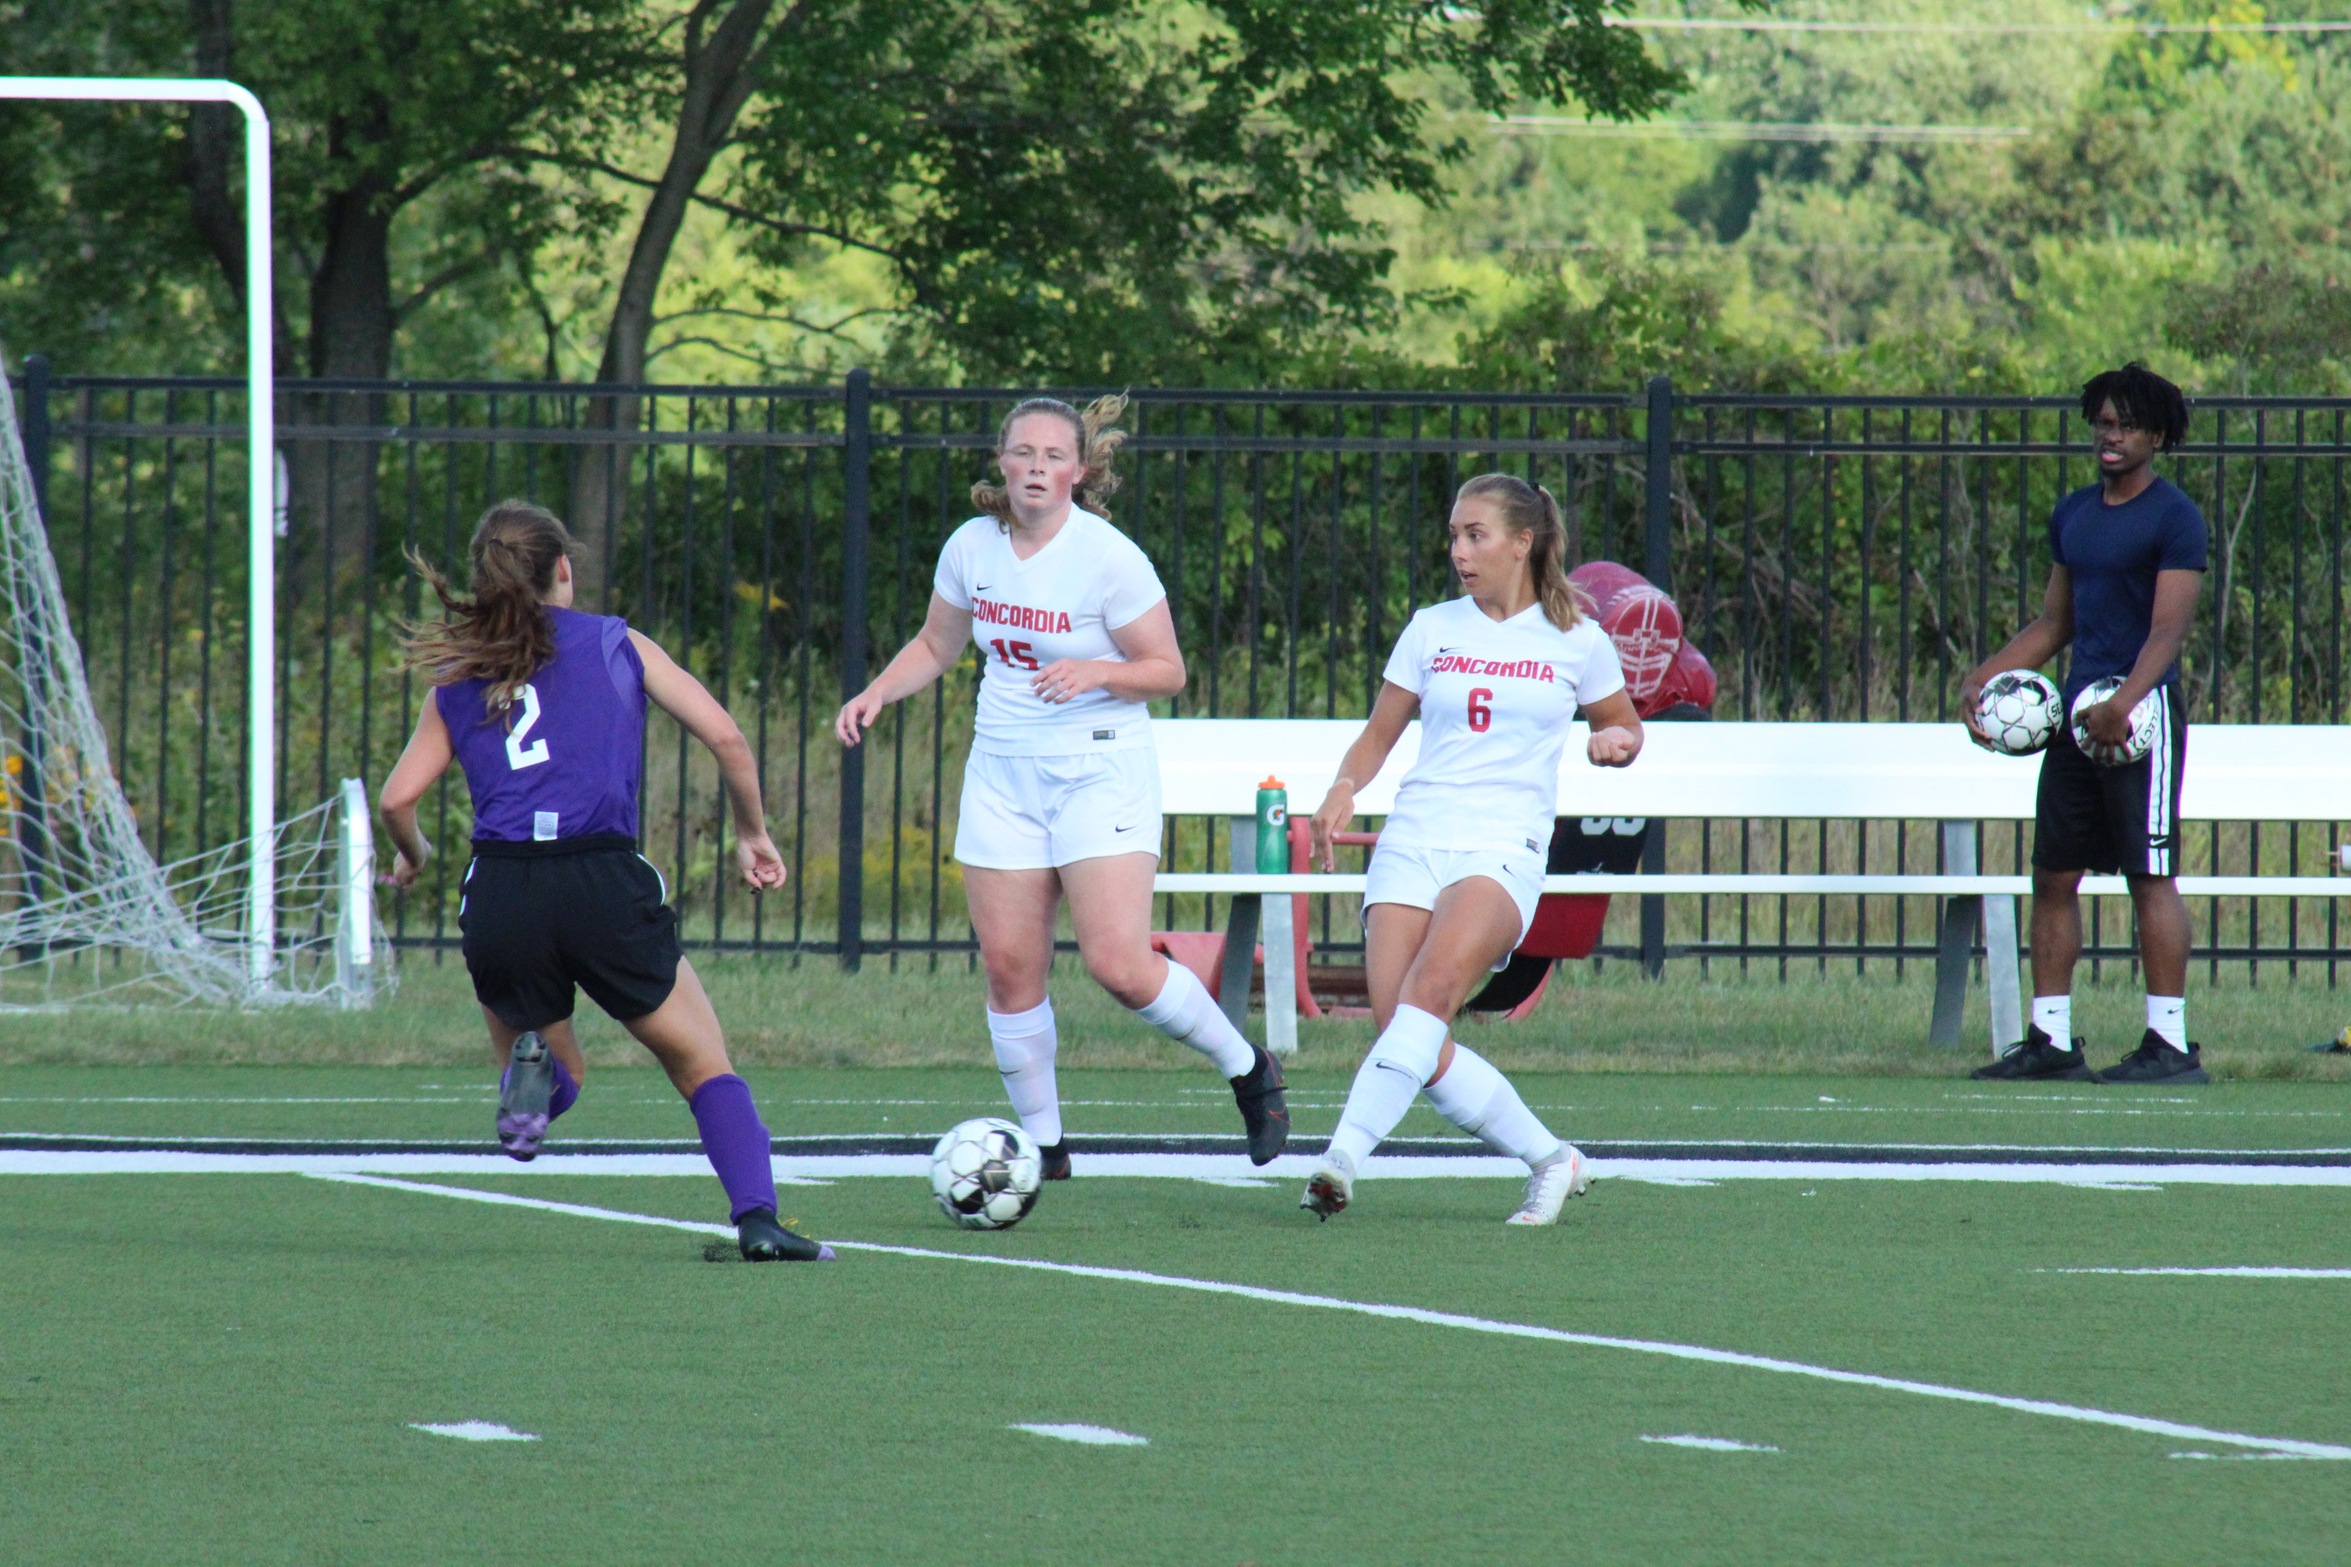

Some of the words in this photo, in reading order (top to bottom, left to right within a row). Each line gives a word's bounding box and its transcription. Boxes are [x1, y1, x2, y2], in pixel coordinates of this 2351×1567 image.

[971, 597, 1072, 634] CONCORDIA
[990, 638, 1040, 671] 15
[1431, 656, 1555, 683] CONCORDIA
[498, 683, 550, 770] 2
[1467, 687, 1494, 733] 6
[1266, 804, 1286, 826] G
